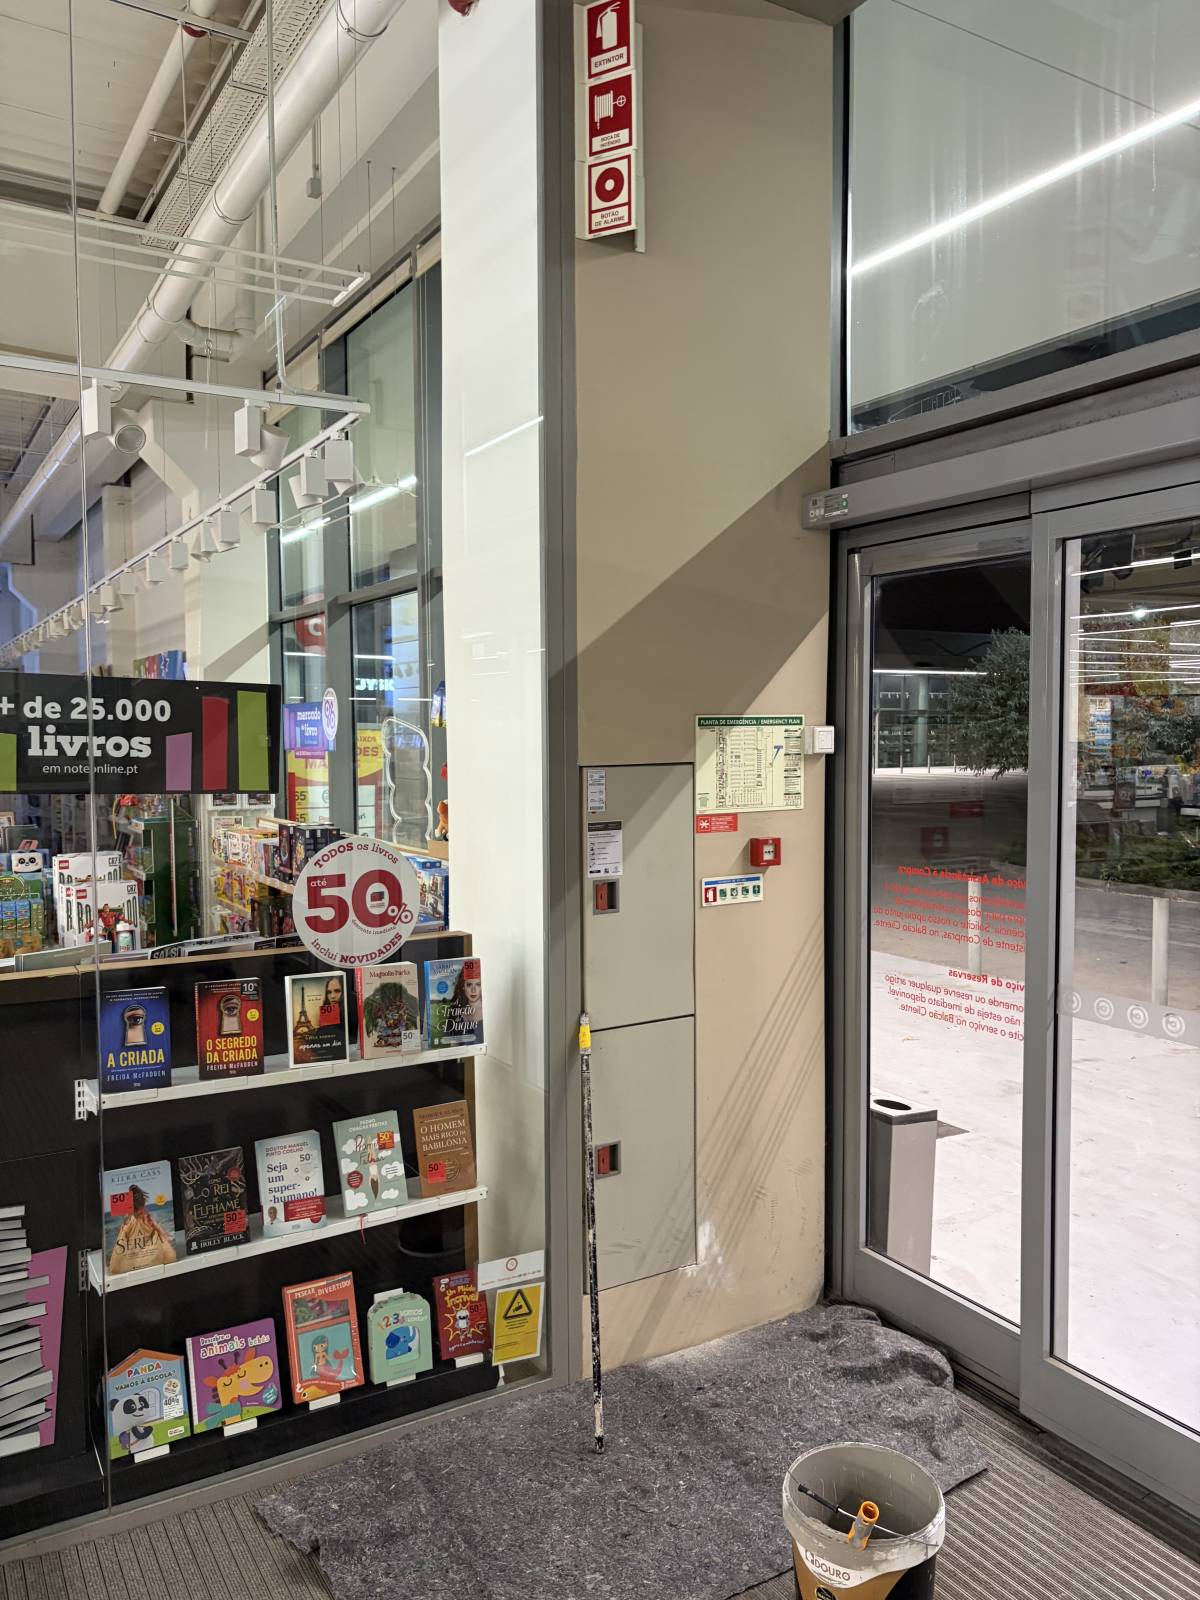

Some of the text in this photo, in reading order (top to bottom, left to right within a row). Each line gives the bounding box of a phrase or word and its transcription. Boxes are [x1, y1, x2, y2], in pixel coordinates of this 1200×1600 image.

[594, 53, 624, 68] EXTINTOR
[603, 215, 625, 225] ALARME
[23, 696, 62, 719] de
[70, 696, 172, 722] 25.000
[788, 717, 801, 725] PLAN
[27, 724, 152, 758] livros
[42, 764, 61, 774] em
[314, 842, 399, 869] TODOS os livros
[310, 878, 328, 887] até
[304, 869, 413, 934] 50%
[311, 932, 403, 964] inclui NOVIDADES
[436, 1018, 478, 1035] Duque
[206, 1035, 257, 1051] O SEGREDO
[107, 1048, 165, 1068] A CRIADA
[206, 1048, 258, 1064] DA CRIADA
[206, 1060, 258, 1072] FREIDA McFADDEN
[107, 1072, 130, 1082] FREIDA
[133, 1070, 166, 1080] McFADDEN
[420, 1119, 466, 1134] O HOMEM
[421, 1134, 440, 1142] MAIS
[440, 1130, 459, 1139] RICO
[266, 1161, 288, 1173] Seja
[268, 1174, 285, 1184] um
[212, 1183, 229, 1196] REI
[268, 1183, 301, 1195] super-
[269, 1188, 318, 1204] -humano!
[392, 1312, 400, 1325] 3
[200, 1336, 246, 1358] animais
[127, 1362, 162, 1377] PANDA
[115, 1380, 139, 1391] VAMOS
